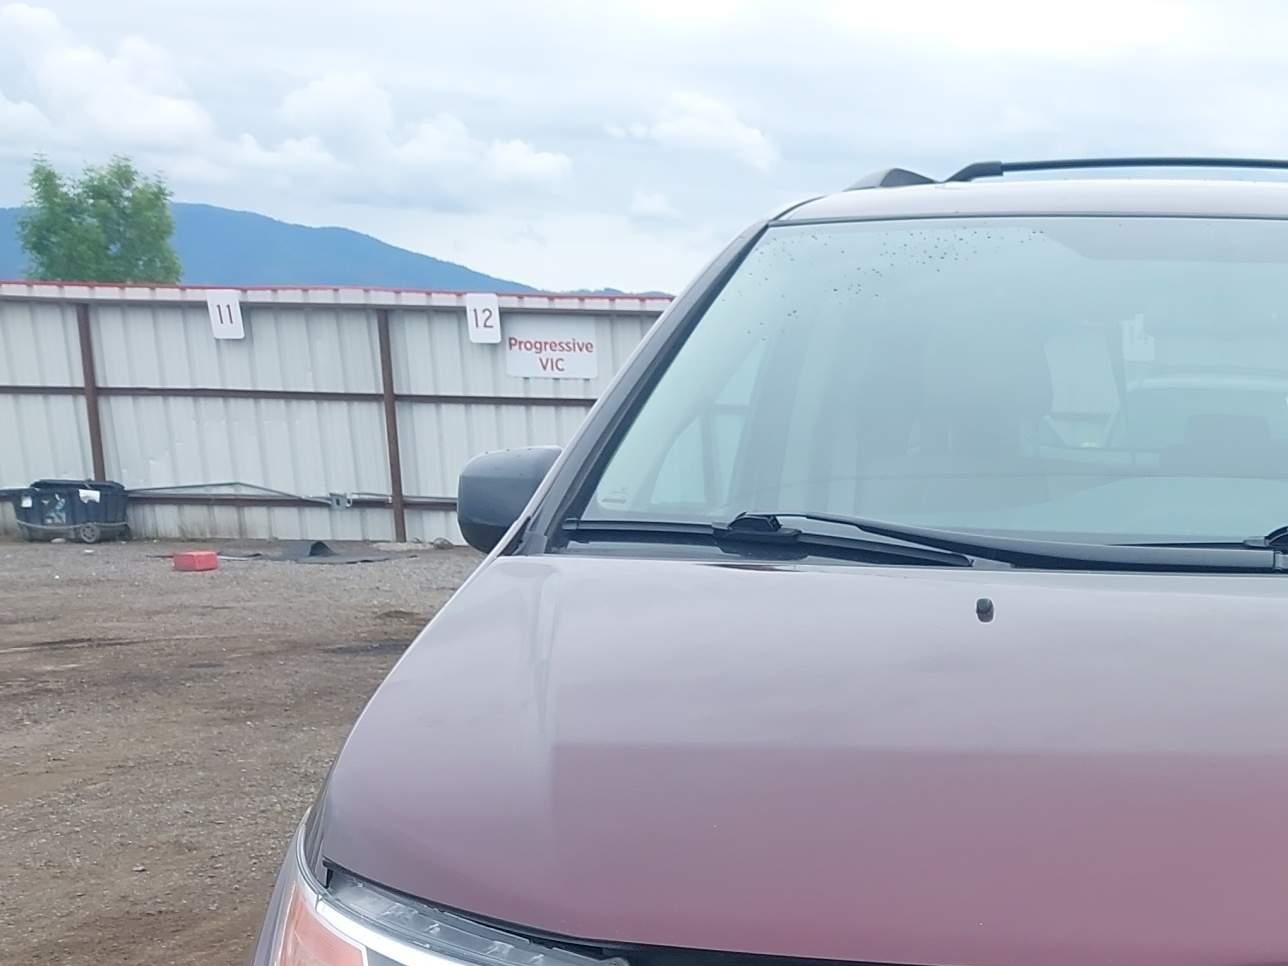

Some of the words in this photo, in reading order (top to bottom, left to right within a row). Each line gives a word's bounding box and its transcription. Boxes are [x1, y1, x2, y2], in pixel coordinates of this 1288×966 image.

[215, 303, 235, 325] 11
[472, 307, 495, 329] 12
[508, 336, 595, 354] Progressive
[538, 357, 566, 372] VIC
